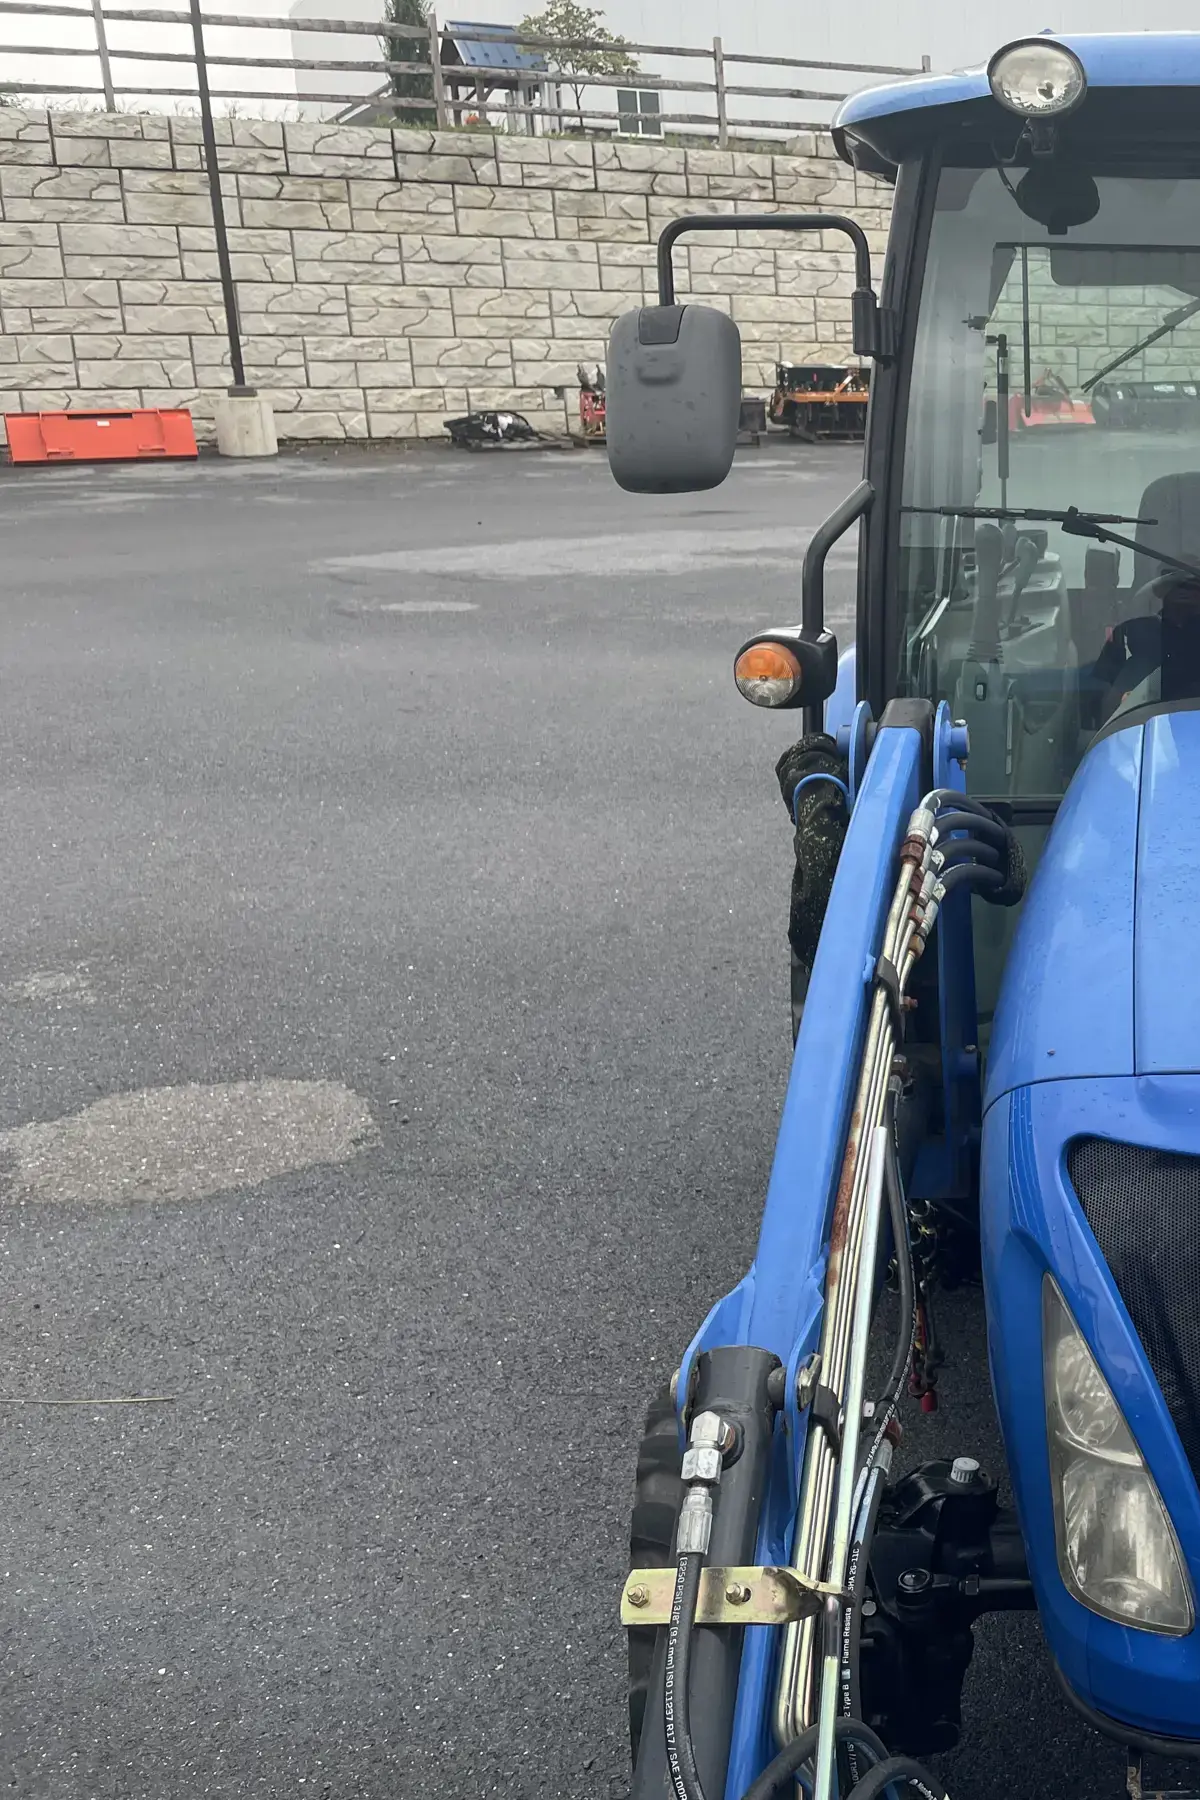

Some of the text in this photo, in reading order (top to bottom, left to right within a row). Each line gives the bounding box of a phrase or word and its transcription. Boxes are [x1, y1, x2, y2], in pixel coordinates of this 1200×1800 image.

[843, 1607, 852, 1637] Resista
[842, 1638, 850, 1664] Flame
[665, 1671, 674, 1688] ISO
[665, 1690, 674, 1721] 11237
[666, 1723, 676, 1744] R17
[669, 1753, 681, 1773] SAE
